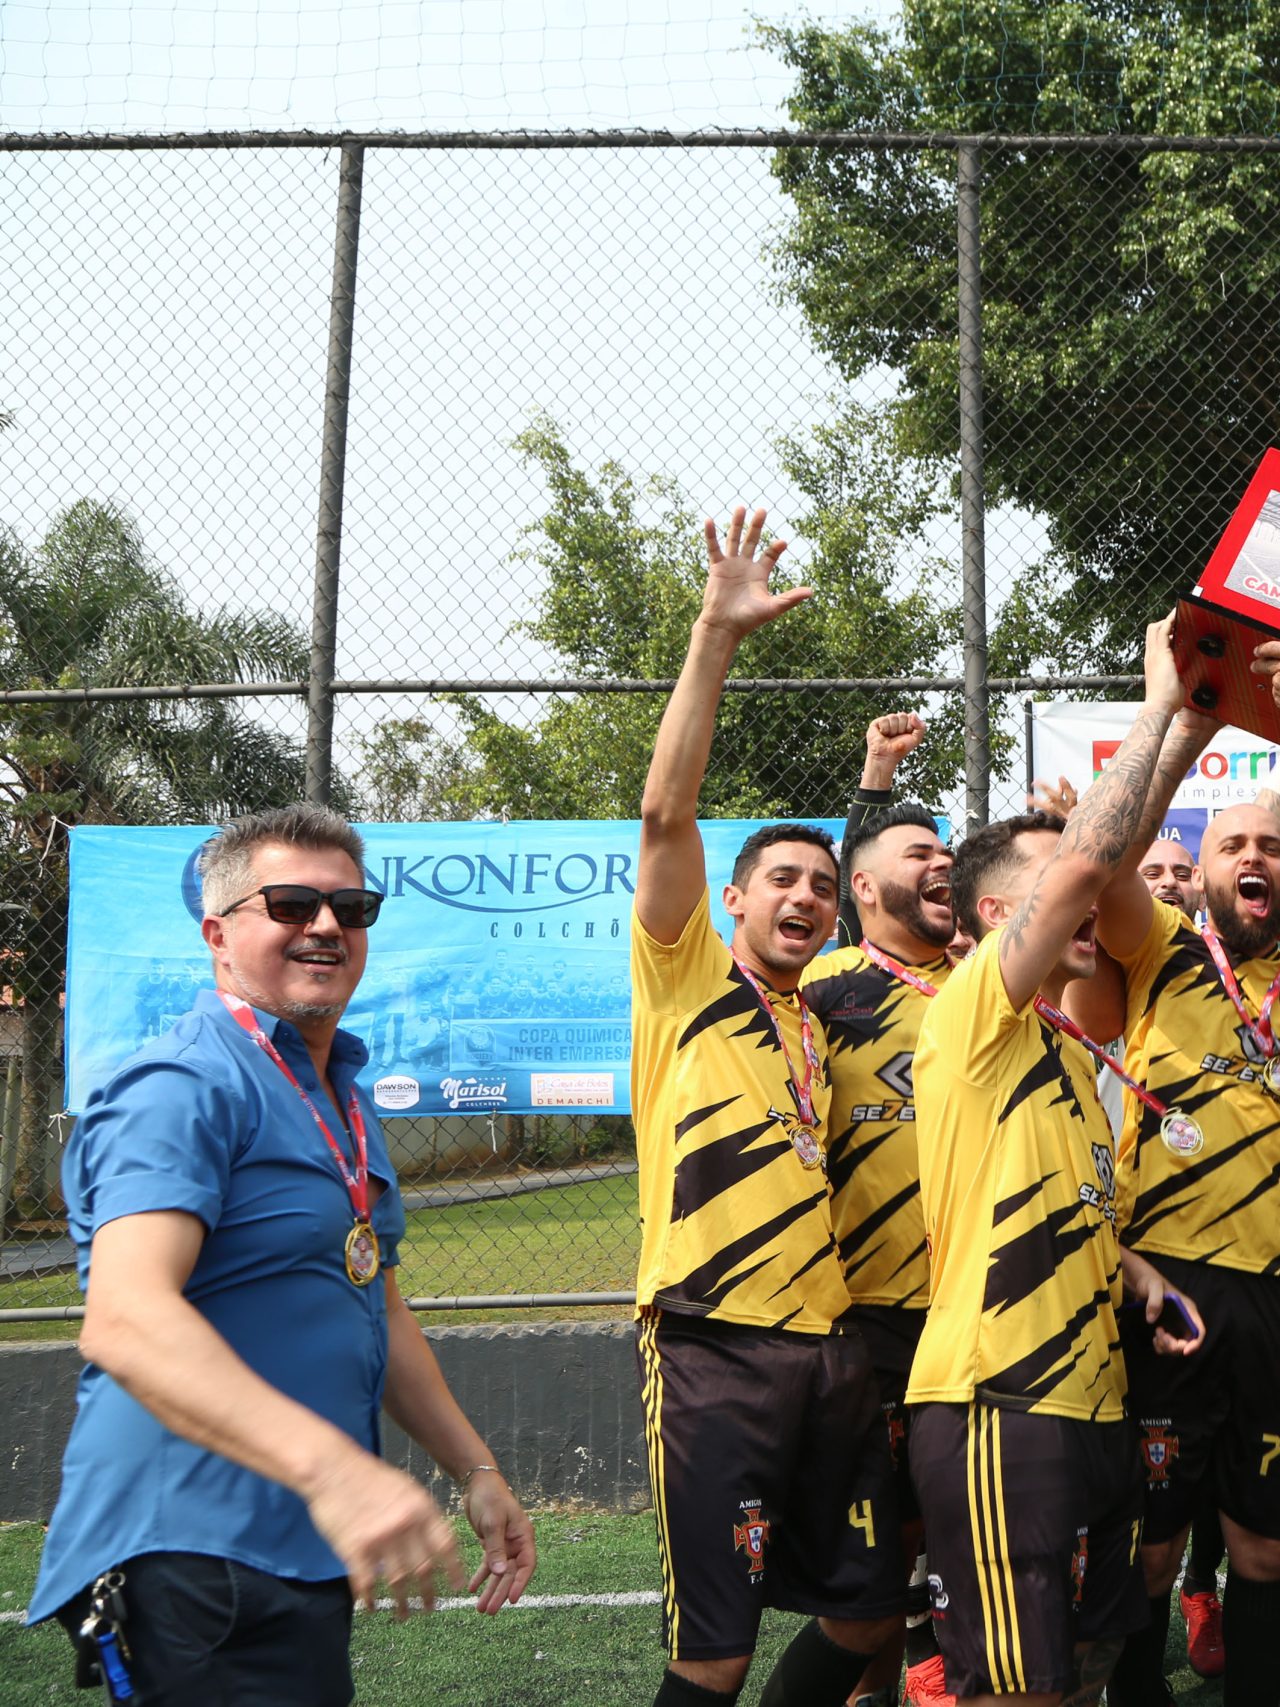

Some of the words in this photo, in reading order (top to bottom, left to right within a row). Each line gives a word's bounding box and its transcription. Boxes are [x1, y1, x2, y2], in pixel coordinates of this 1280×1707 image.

[1175, 785, 1257, 800] imples
[490, 918, 620, 939] COLCHÕ
[518, 1028, 560, 1044] COPA
[508, 1046, 553, 1061] INTER
[559, 1046, 632, 1061] EMPRESA
[439, 1077, 507, 1109] Marisol
[537, 1097, 609, 1105] DEMARCHI
[851, 1099, 916, 1121] SE7E
[1139, 1418, 1172, 1426] AMIGOS
[848, 1499, 876, 1548] 4
